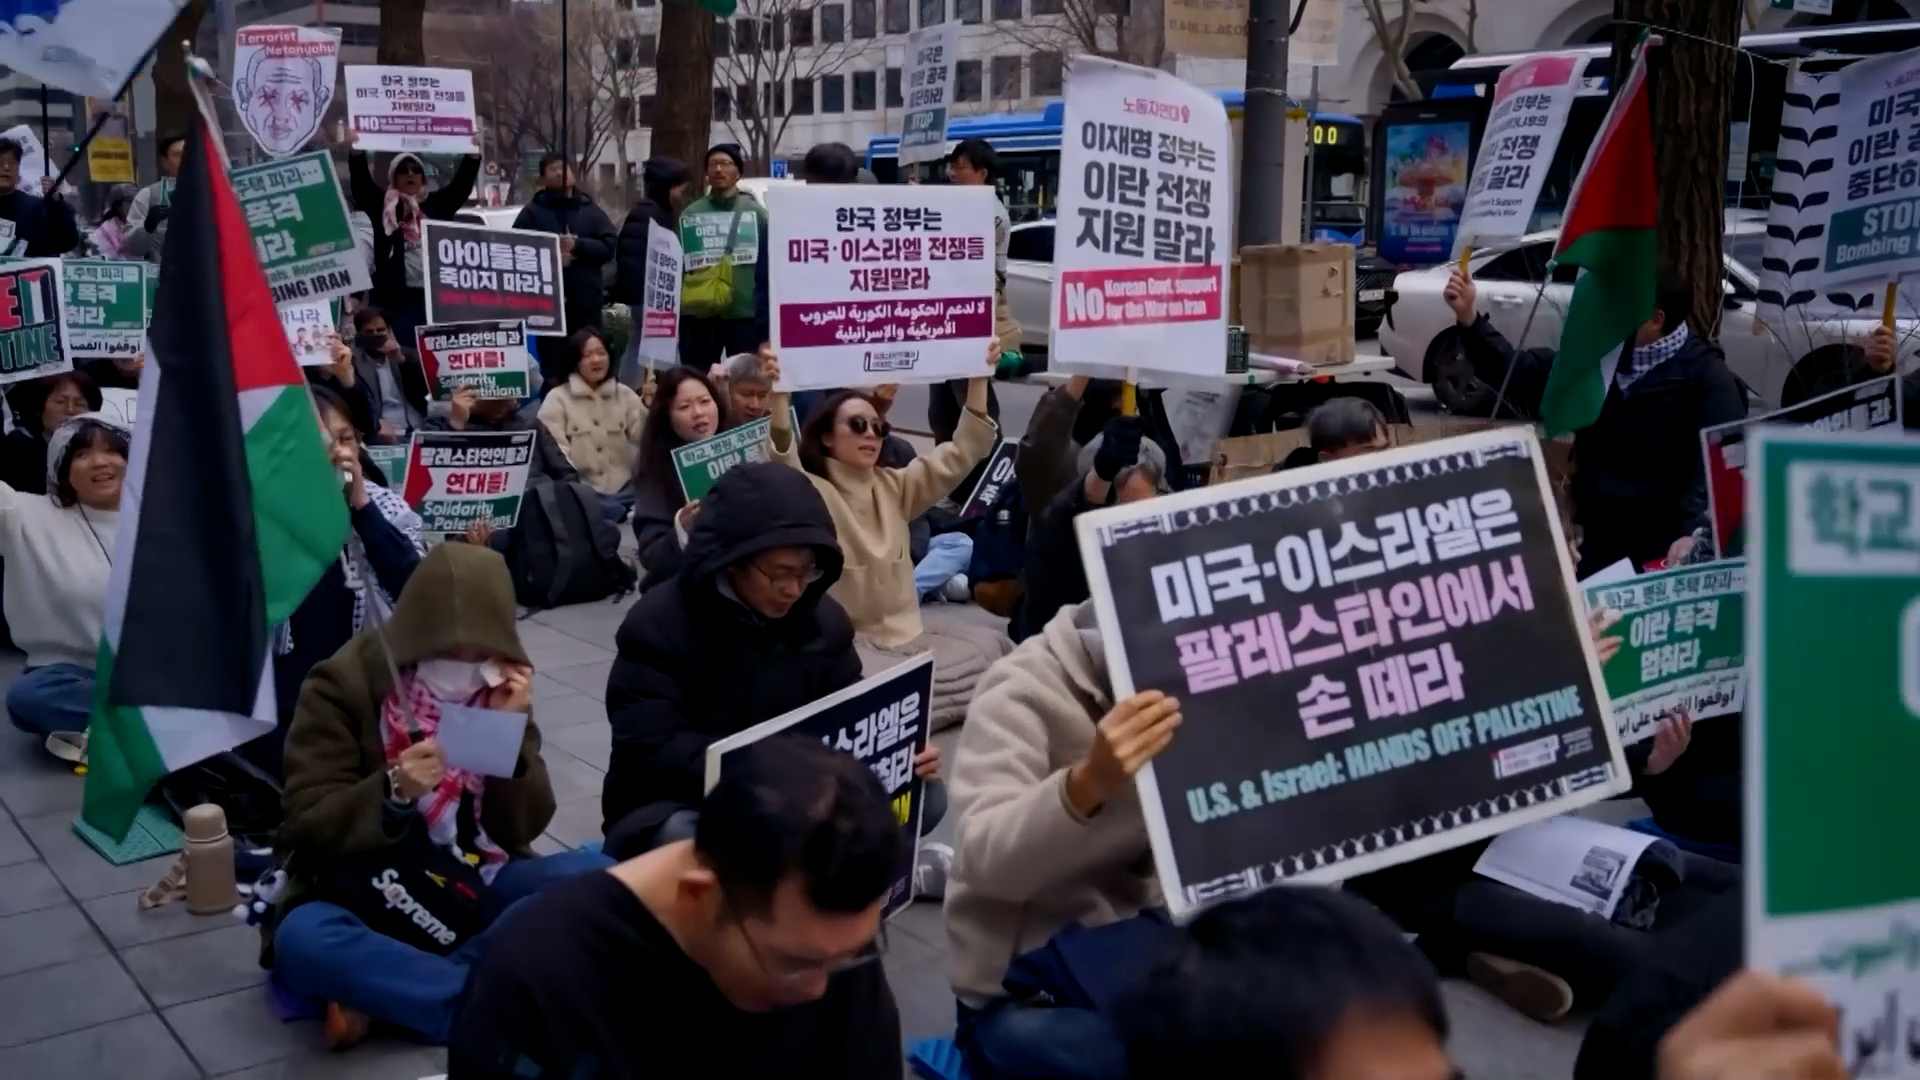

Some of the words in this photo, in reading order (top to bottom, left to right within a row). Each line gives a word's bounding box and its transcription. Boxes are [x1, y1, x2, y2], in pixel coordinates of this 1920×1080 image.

[239, 32, 296, 44] Terrorist
[266, 44, 334, 56] Netanyahu
[359, 116, 380, 131] NO
[1122, 98, 1180, 122] 노동자연대
[1081, 120, 1152, 160] 이재명
[1157, 132, 1216, 173] 정부는
[1498, 134, 1541, 160] 전쟁
[1848, 128, 1899, 166] 이란
[1083, 161, 1150, 208] 이란
[1156, 171, 1212, 219] 전쟁
[1486, 165, 1530, 190] 말라
[835, 207, 876, 232] 한국
[883, 207, 943, 232] 정부는
[788, 237, 923, 264] 미국·이스라엘
[928, 236, 985, 262] 전쟁들
[1075, 207, 1146, 258] 지원
[1153, 218, 1216, 266] 말라
[1835, 235, 1910, 264] Bombing
[438, 238, 539, 273] 아이들을
[310, 270, 352, 293] IRAN
[439, 266, 498, 292] 죽이지
[849, 267, 931, 292] 지원말라
[1065, 282, 1104, 322] No
[1104, 279, 1147, 297] Korean
[1175, 275, 1217, 294] support
[1183, 299, 1206, 315] Iran
[440, 373, 496, 388] Solidarity
[423, 501, 494, 517] Solidarity
[1150, 488, 1523, 626] 미국·이스라엘은
[1173, 554, 1536, 696] 팔레스타인에서
[1630, 608, 1671, 648] 이란
[1674, 599, 1720, 634] 폭격
[1640, 637, 1701, 684] 멈춰라
[1296, 673, 1356, 740] 손
[1357, 642, 1466, 722] 떼라
[1186, 785, 1237, 824] U.S.
[1239, 783, 1264, 809] &
[1343, 731, 1431, 780] HANDS
[1430, 716, 1476, 757] OFF
[1474, 684, 1586, 745] PALESTINE
